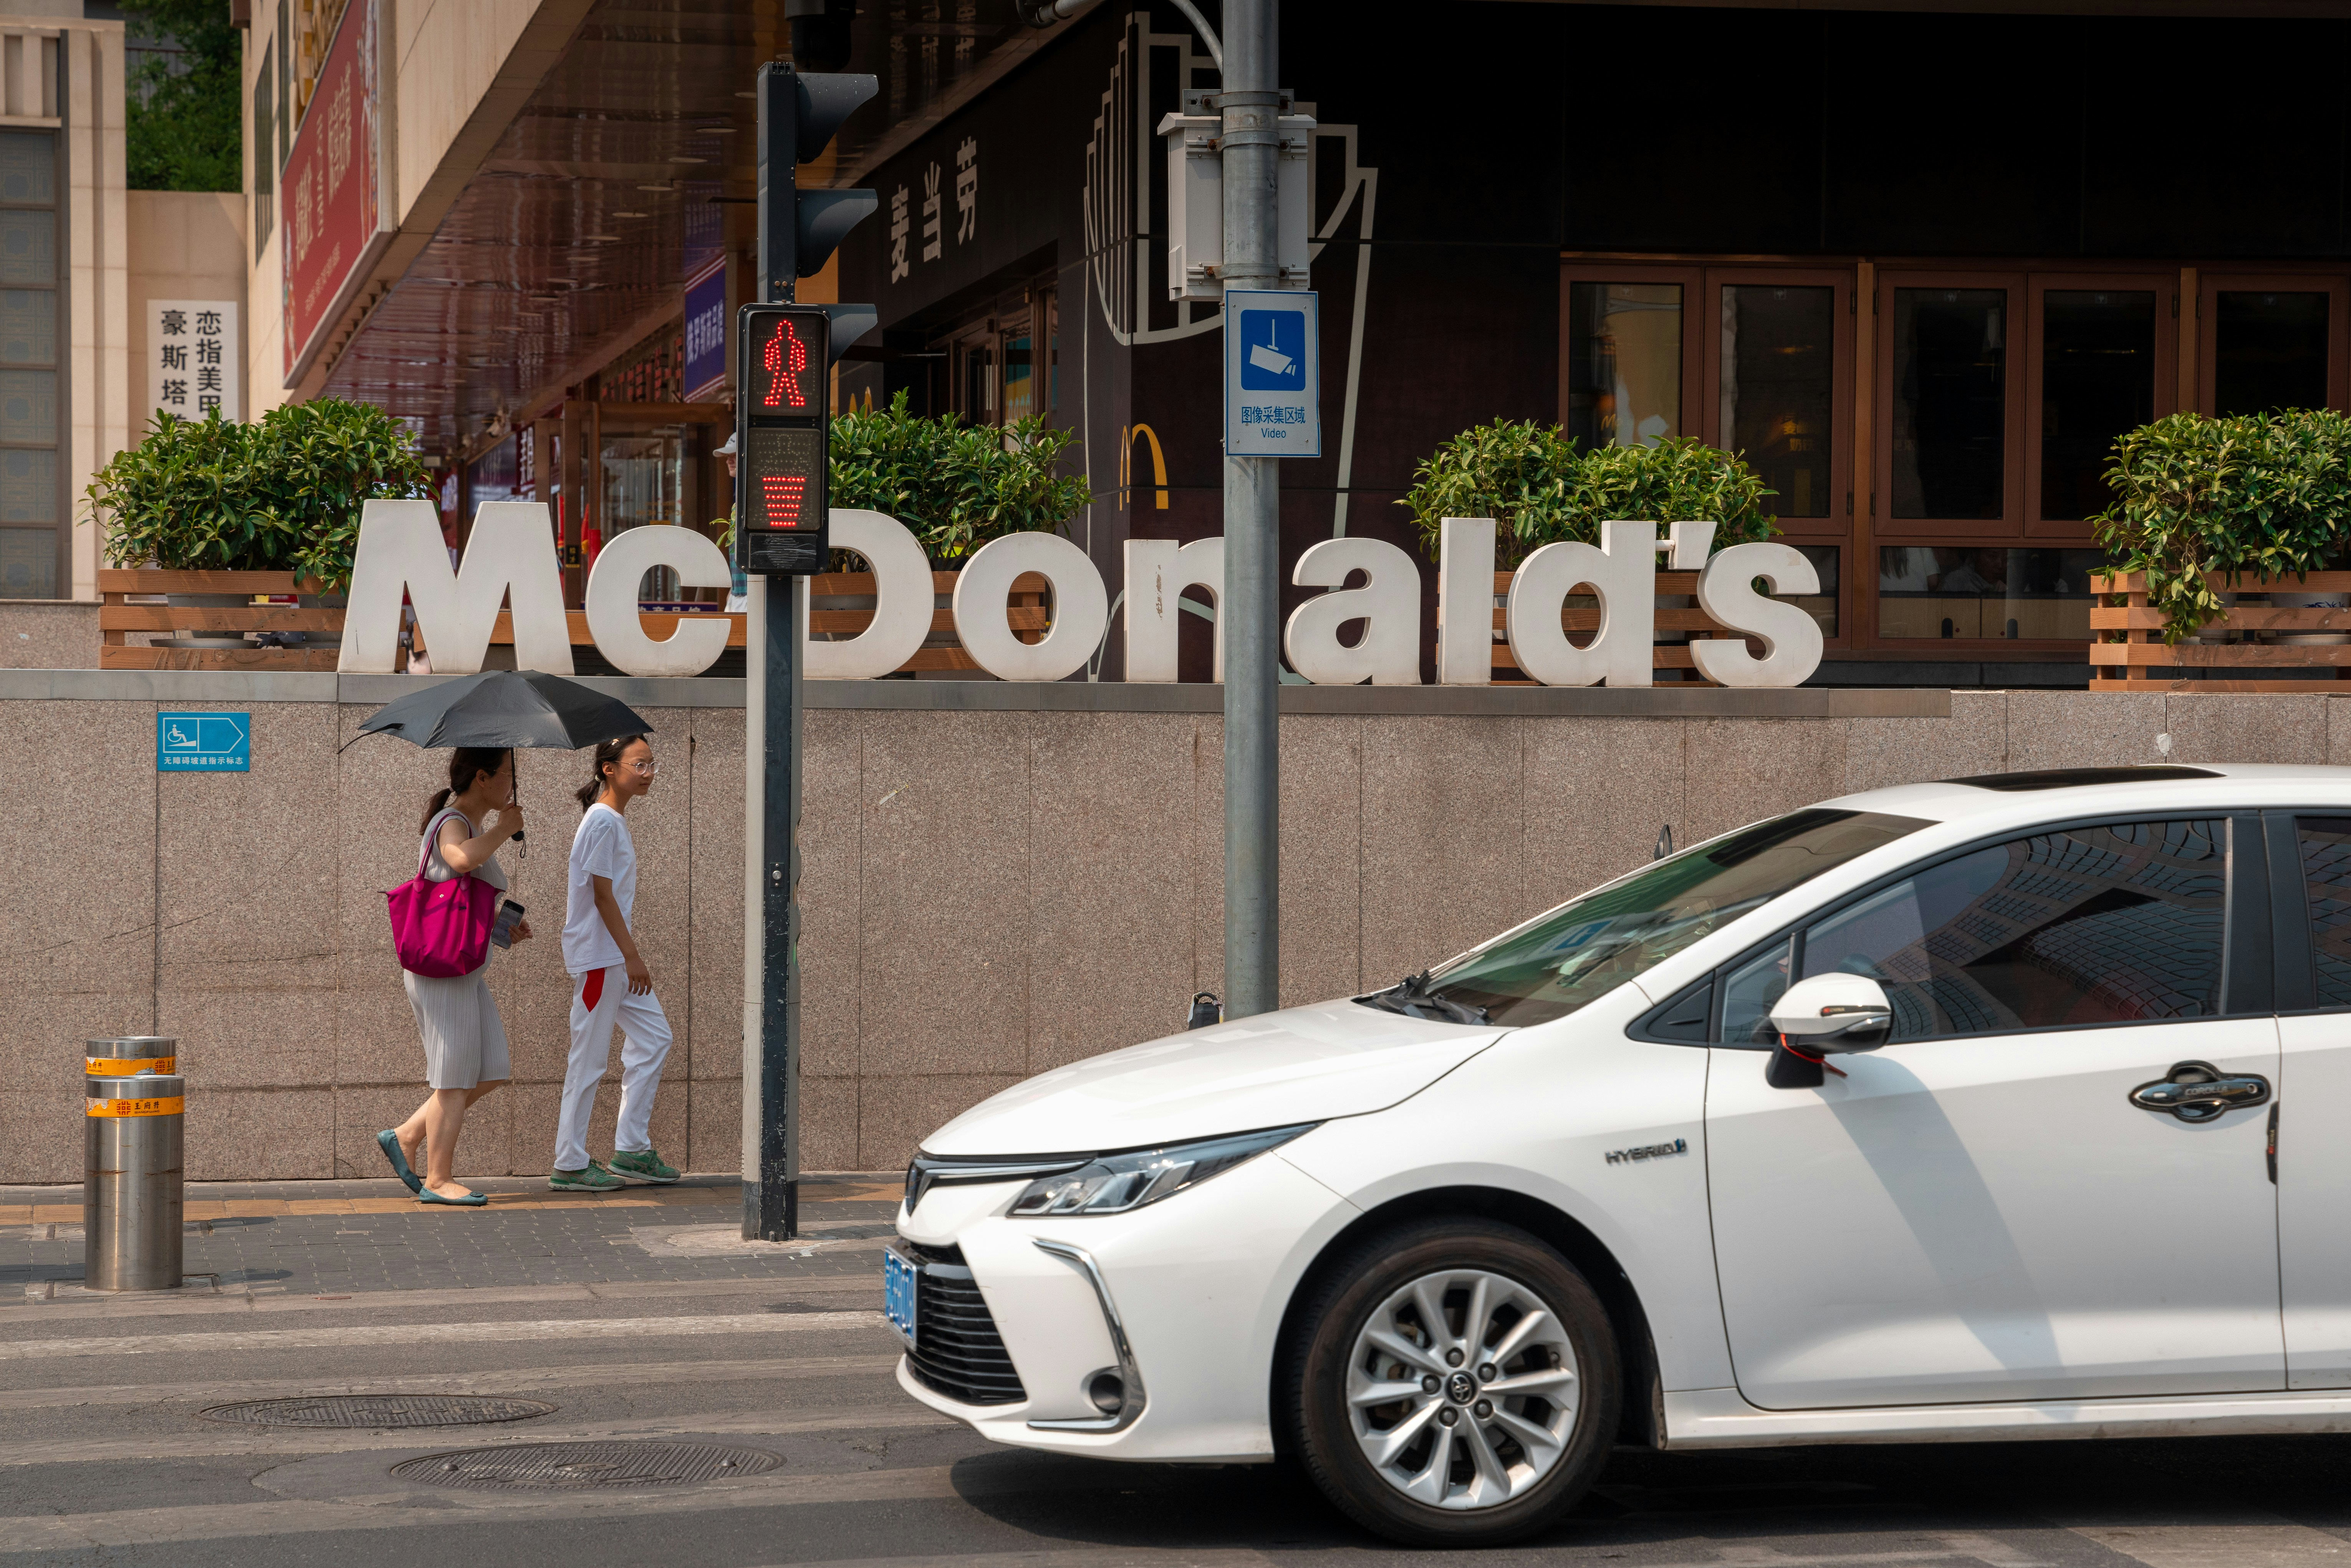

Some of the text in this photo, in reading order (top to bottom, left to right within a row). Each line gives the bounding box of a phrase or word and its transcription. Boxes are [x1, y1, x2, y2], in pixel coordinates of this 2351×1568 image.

[891, 135, 978, 284] 麦当劳
[161, 309, 188, 427] 豪斯塔
[196, 310, 222, 419] 恋指美甲
[1241, 406, 1306, 424] 图像采集区域
[1261, 428, 1286, 438] Video
[337, 499, 1824, 688] McDonald's
[164, 757, 243, 765] 无障碍坡道指示标志
[134, 1101, 159, 1109] 王府井
[1605, 1143, 1674, 1163] HYBRID
